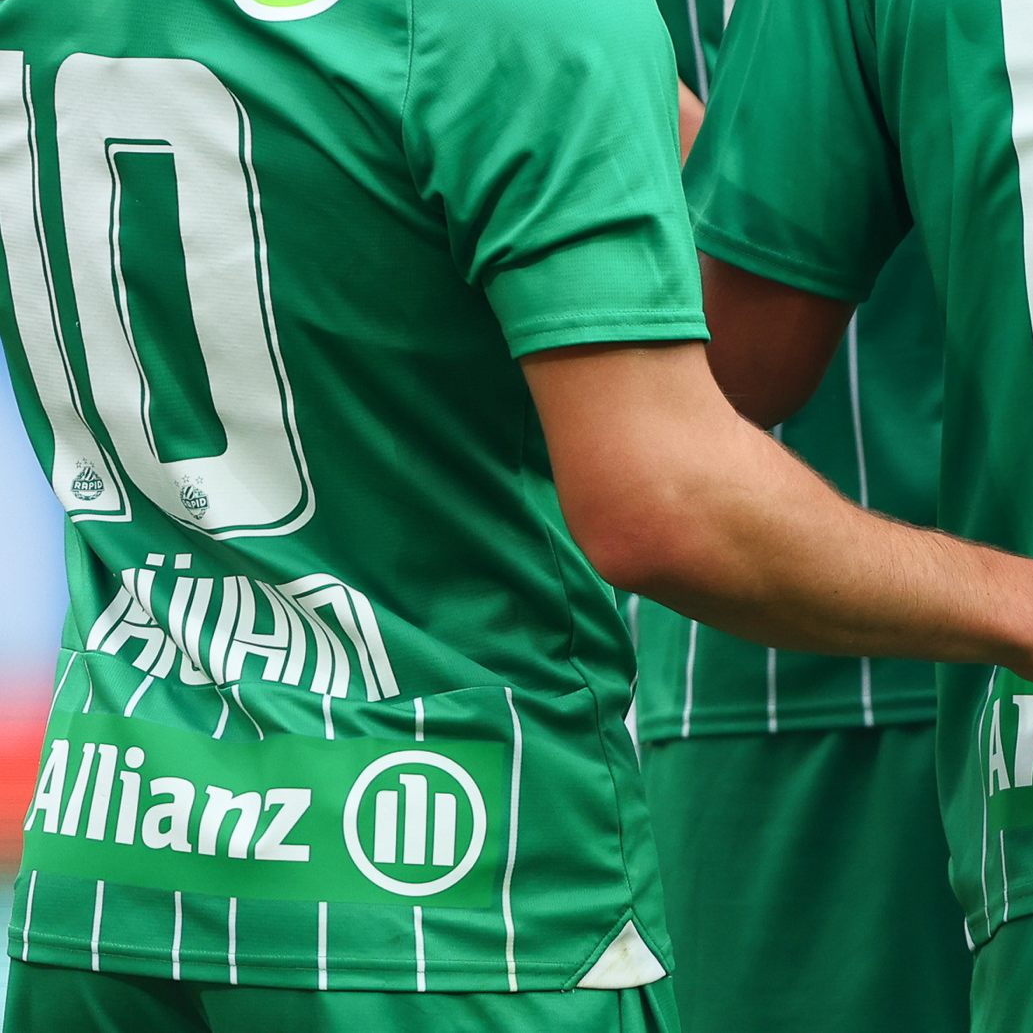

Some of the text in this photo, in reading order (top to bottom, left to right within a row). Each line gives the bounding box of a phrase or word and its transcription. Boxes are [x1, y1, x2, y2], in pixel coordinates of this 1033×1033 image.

[0, 50, 316, 540] 10
[73, 479, 103, 491] RAPID
[24, 738, 312, 862] Allianz
